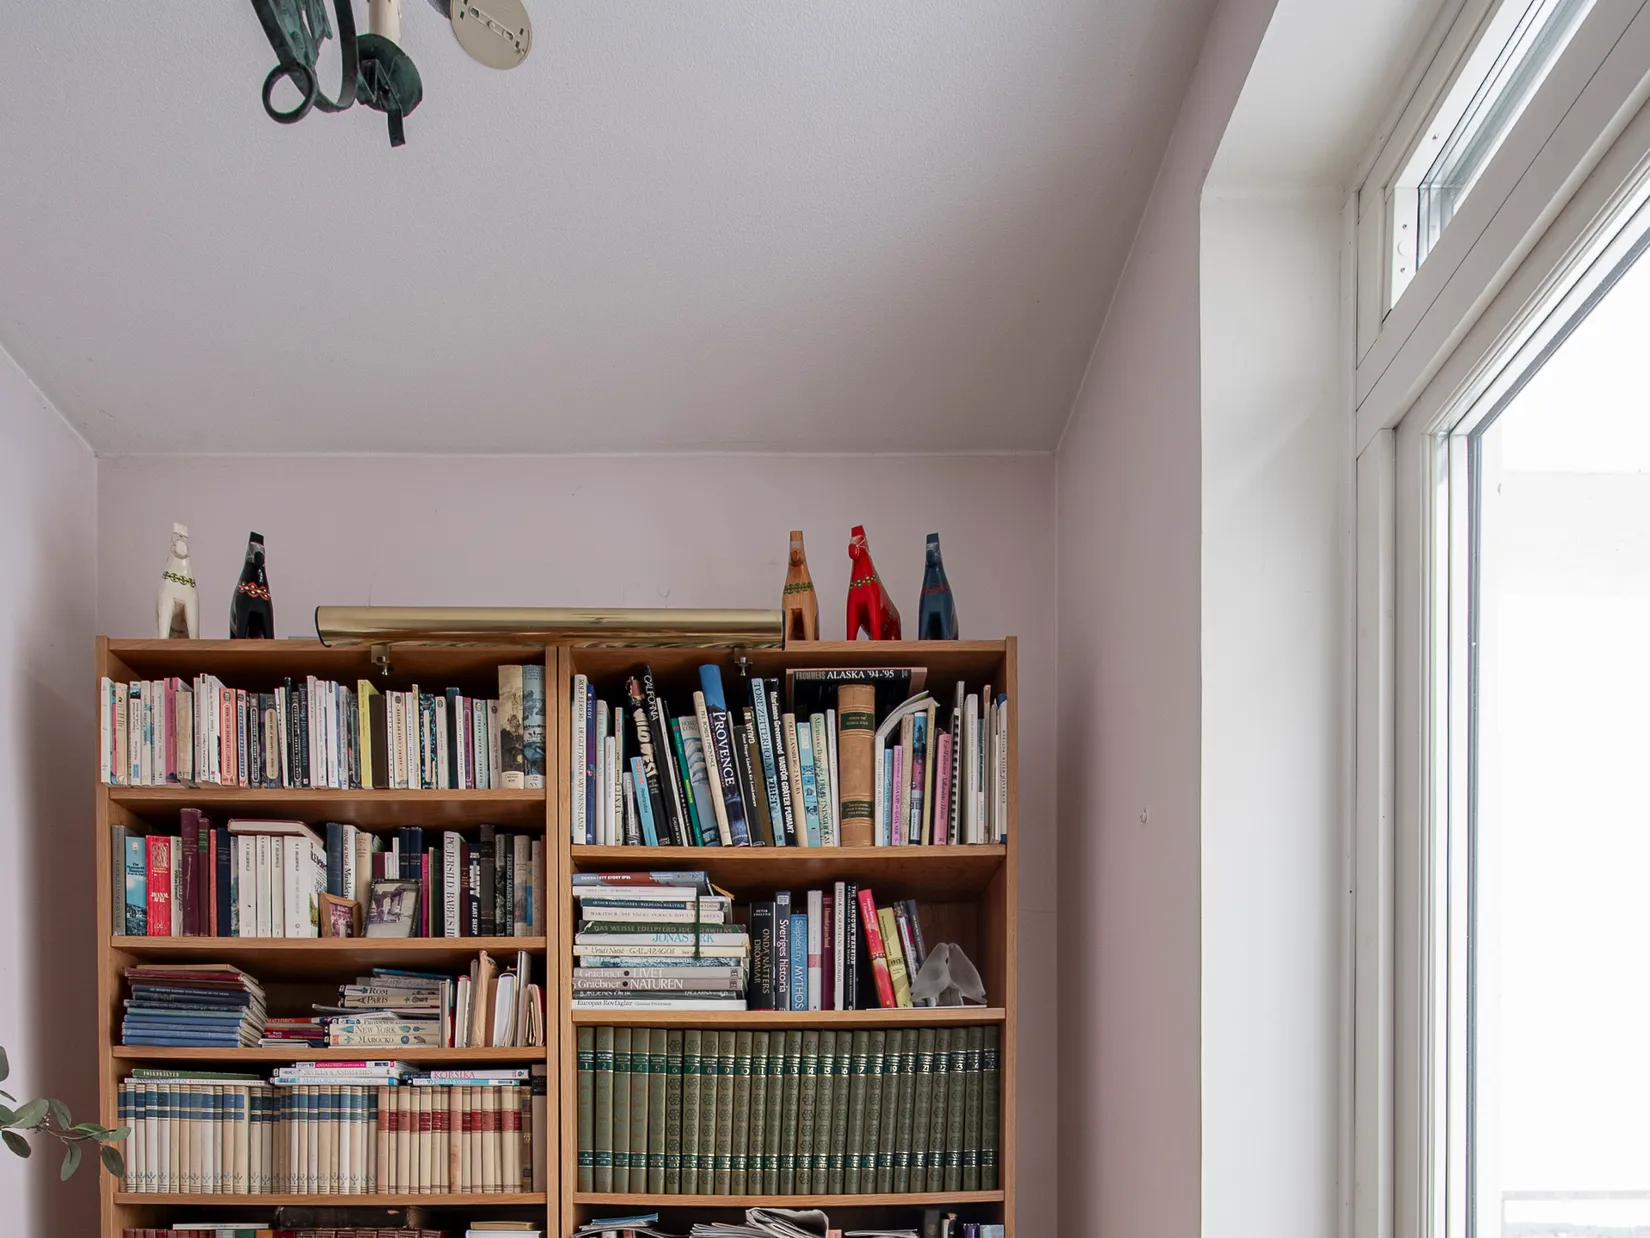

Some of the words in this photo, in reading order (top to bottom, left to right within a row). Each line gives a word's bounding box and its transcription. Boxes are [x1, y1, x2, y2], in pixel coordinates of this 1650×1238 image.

[826, 671, 865, 679] ALASKA
[644, 675, 658, 721] CALIFORNIA
[754, 683, 762, 707] TORE
[633, 708, 651, 743] WILD
[642, 743, 658, 778] WEST
[756, 709, 773, 771] ZETTERHOLM
[713, 711, 735, 787] PROVENCE
[770, 692, 778, 720] Marianne
[774, 720, 784, 754] Greenwood
[784, 806, 794, 834] PUMAN?
[768, 775, 778, 806] TIBET
[446, 836, 455, 848] PC
[446, 849, 455, 888] JERSILD
[447, 892, 456, 926] BABELS
[652, 932, 689, 943] JONAS
[777, 919, 789, 957] Sveriges
[795, 920, 803, 950] Stephen
[629, 947, 675, 955] GALAPAGOS
[795, 951, 803, 962] Fry
[754, 939, 763, 984] DRÖMMAR
[632, 968, 664, 978] LIVET
[763, 955, 771, 994] NÄTTERS
[779, 959, 790, 993] historia
[578, 980, 621, 988] Graebner
[630, 979, 683, 990] NATUREN
[794, 965, 804, 1009] MYTHOS
[369, 987, 388, 995] ROM
[367, 996, 389, 1004] PARIS
[355, 1025, 375, 1034] NEW
[375, 1025, 396, 1034] YORK
[358, 1036, 395, 1044] MAROCKO
[741, 1067, 750, 1075] 10
[757, 1067, 764, 1075] 11
[773, 1067, 781, 1075] 12
[807, 1067, 814, 1075] 14
[955, 1063, 964, 1071] 23
[434, 1071, 476, 1079] KORSIKA
